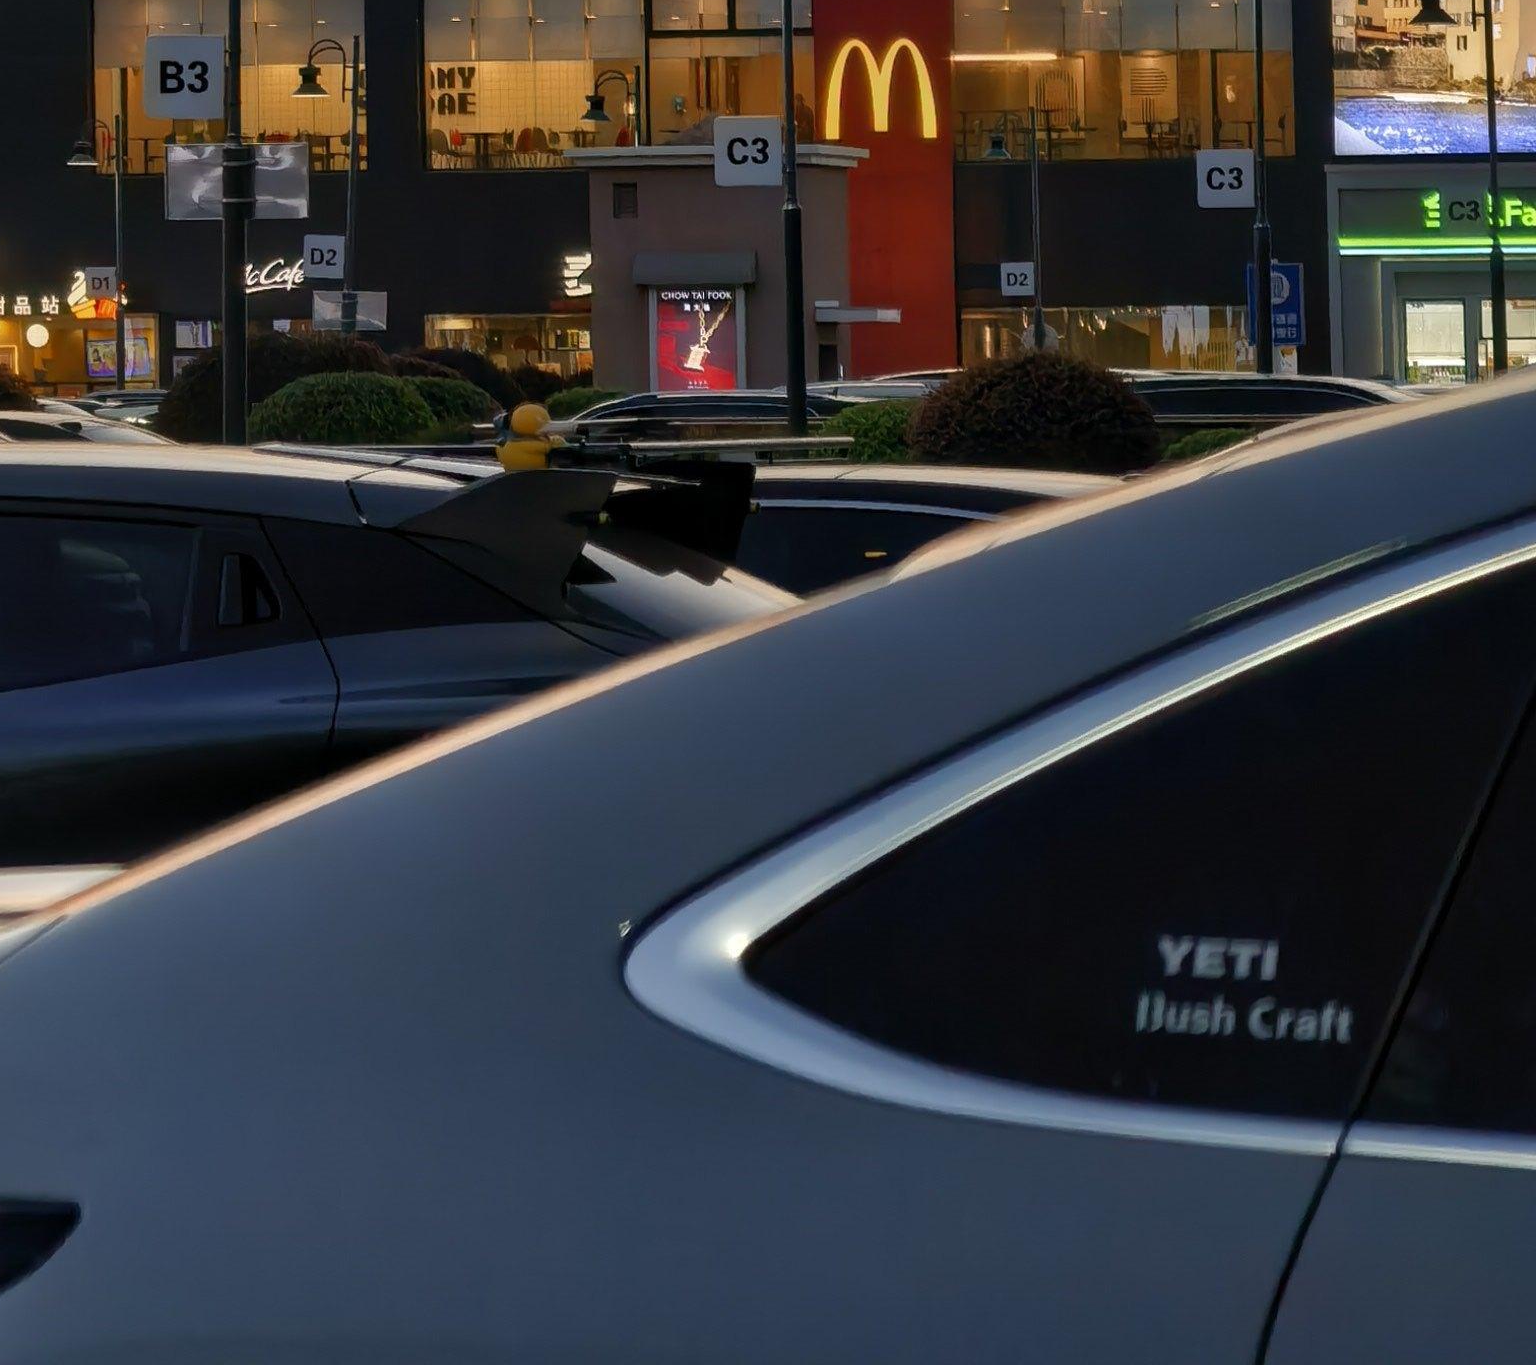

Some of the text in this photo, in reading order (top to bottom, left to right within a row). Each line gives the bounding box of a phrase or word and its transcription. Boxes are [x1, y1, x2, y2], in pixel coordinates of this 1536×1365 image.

[159, 60, 209, 94] B3
[726, 137, 770, 166] C3
[1206, 166, 1244, 191] C3
[1448, 200, 1481, 221] C3
[310, 247, 337, 266] D2
[91, 277, 110, 290] D1
[1006, 273, 1029, 287] D2
[692, 291, 705, 300] TAI
[1158, 935, 1280, 981] YETI
[1247, 996, 1353, 1044] Craft
